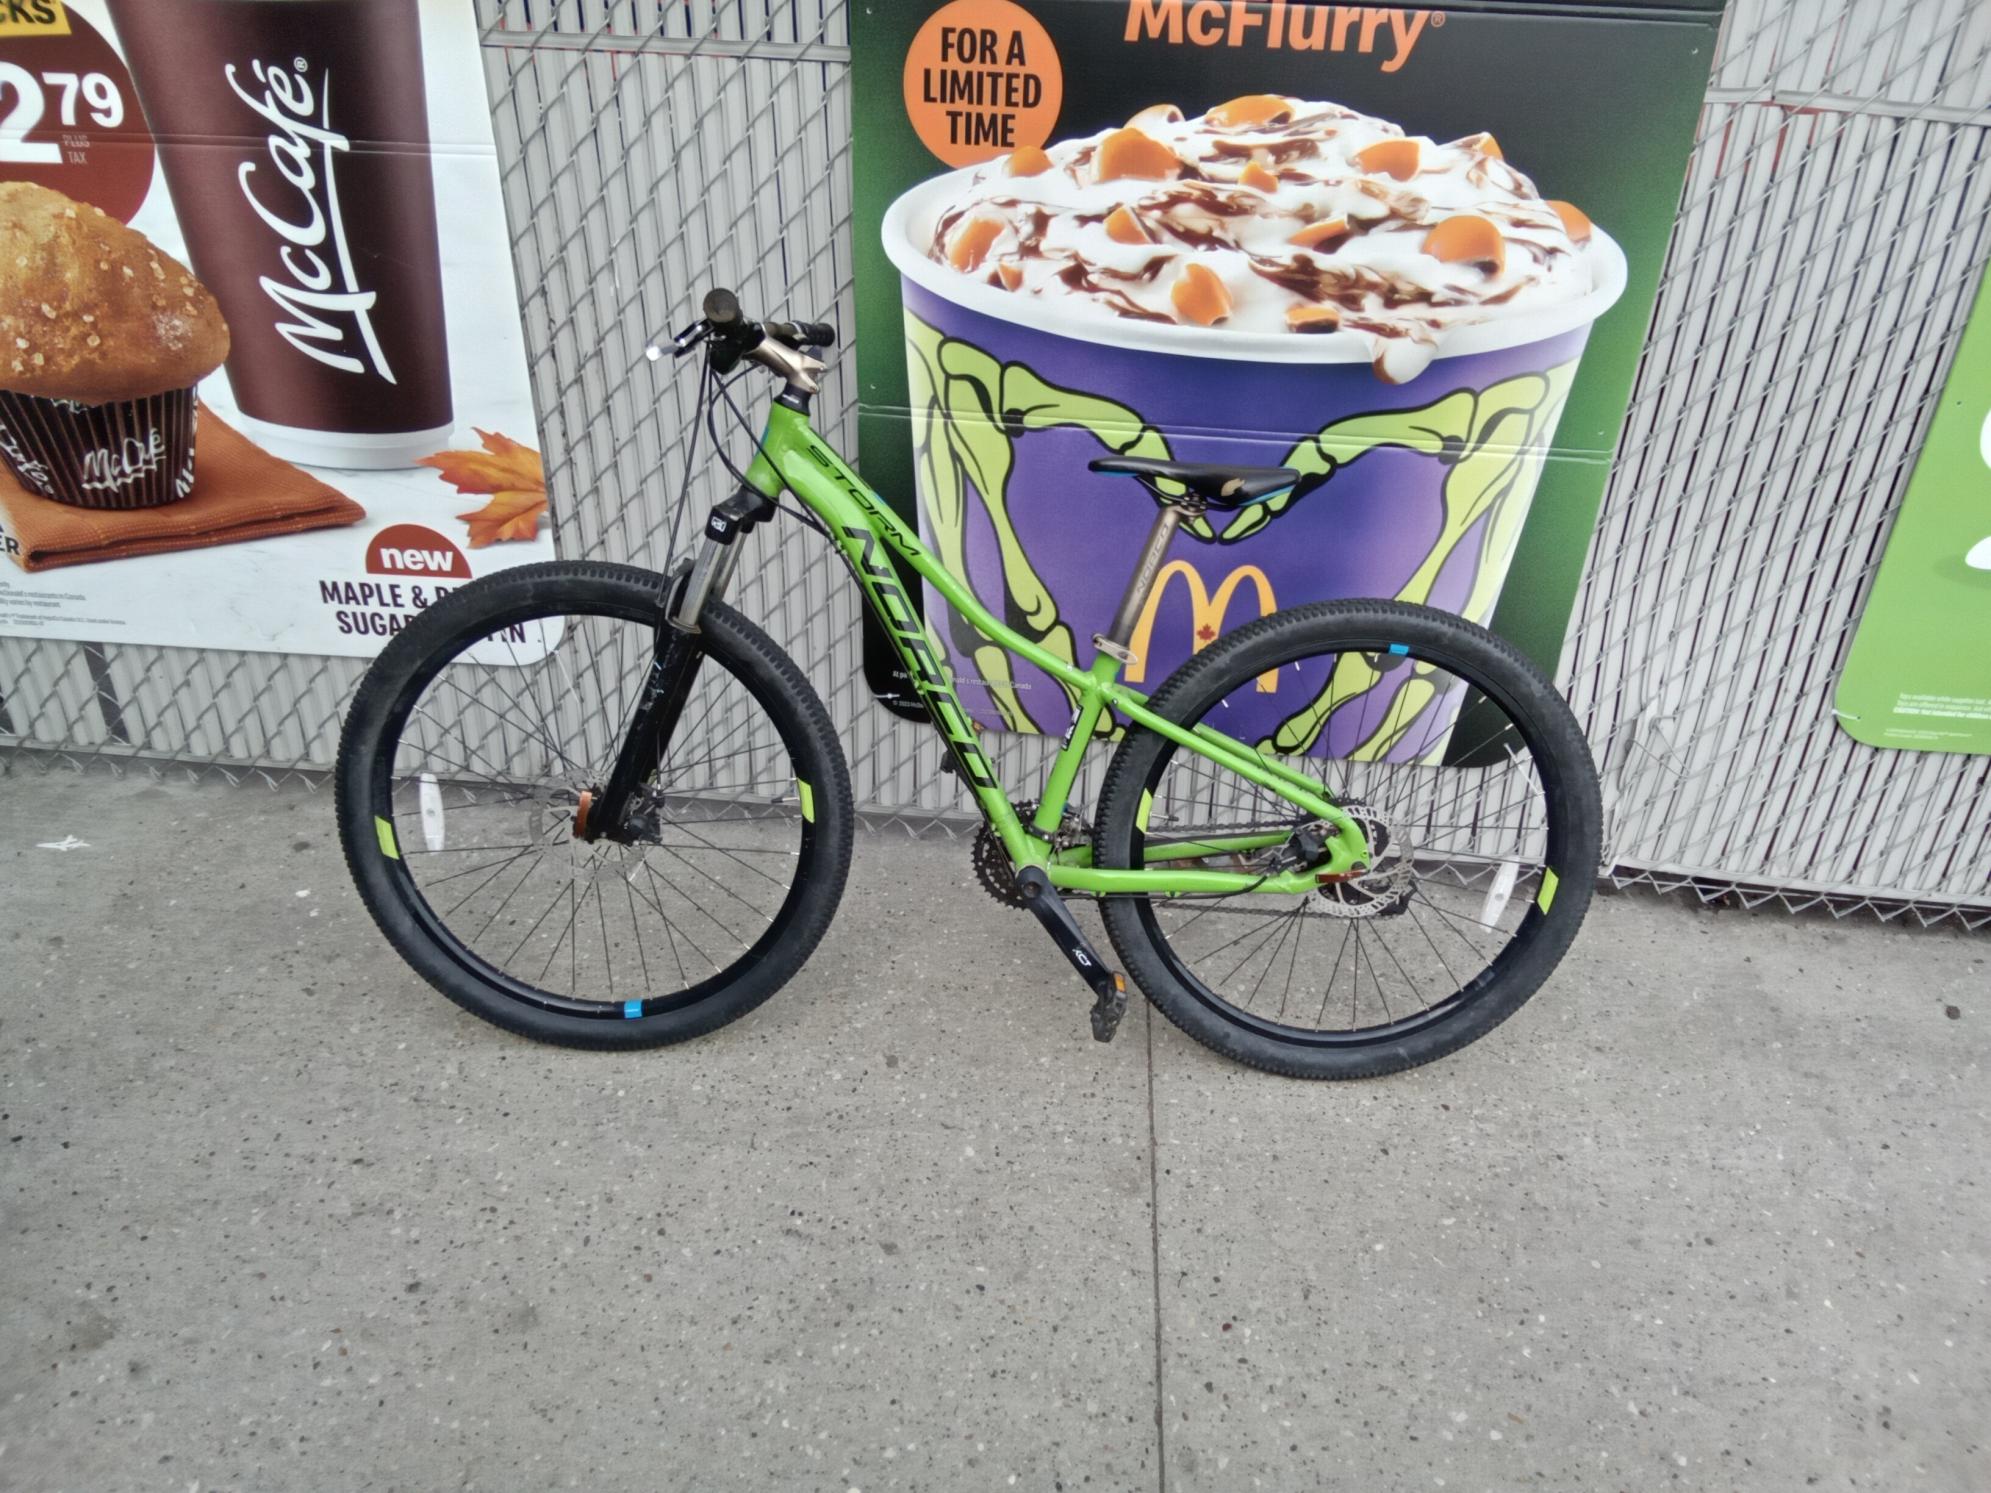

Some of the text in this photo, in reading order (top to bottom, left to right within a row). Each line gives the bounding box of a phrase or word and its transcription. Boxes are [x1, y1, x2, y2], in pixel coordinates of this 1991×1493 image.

[940, 27, 1027, 67] FOR A
[923, 69, 1042, 109] LIMITED
[62, 134, 90, 148] PLUS
[945, 111, 1015, 148] TIME
[67, 151, 88, 164] TAX
[806, 444, 922, 557] STORM
[379, 547, 453, 572] new
[319, 580, 405, 608] MAPLE
[411, 585, 428, 609] &
[842, 525, 998, 789] NORCO
